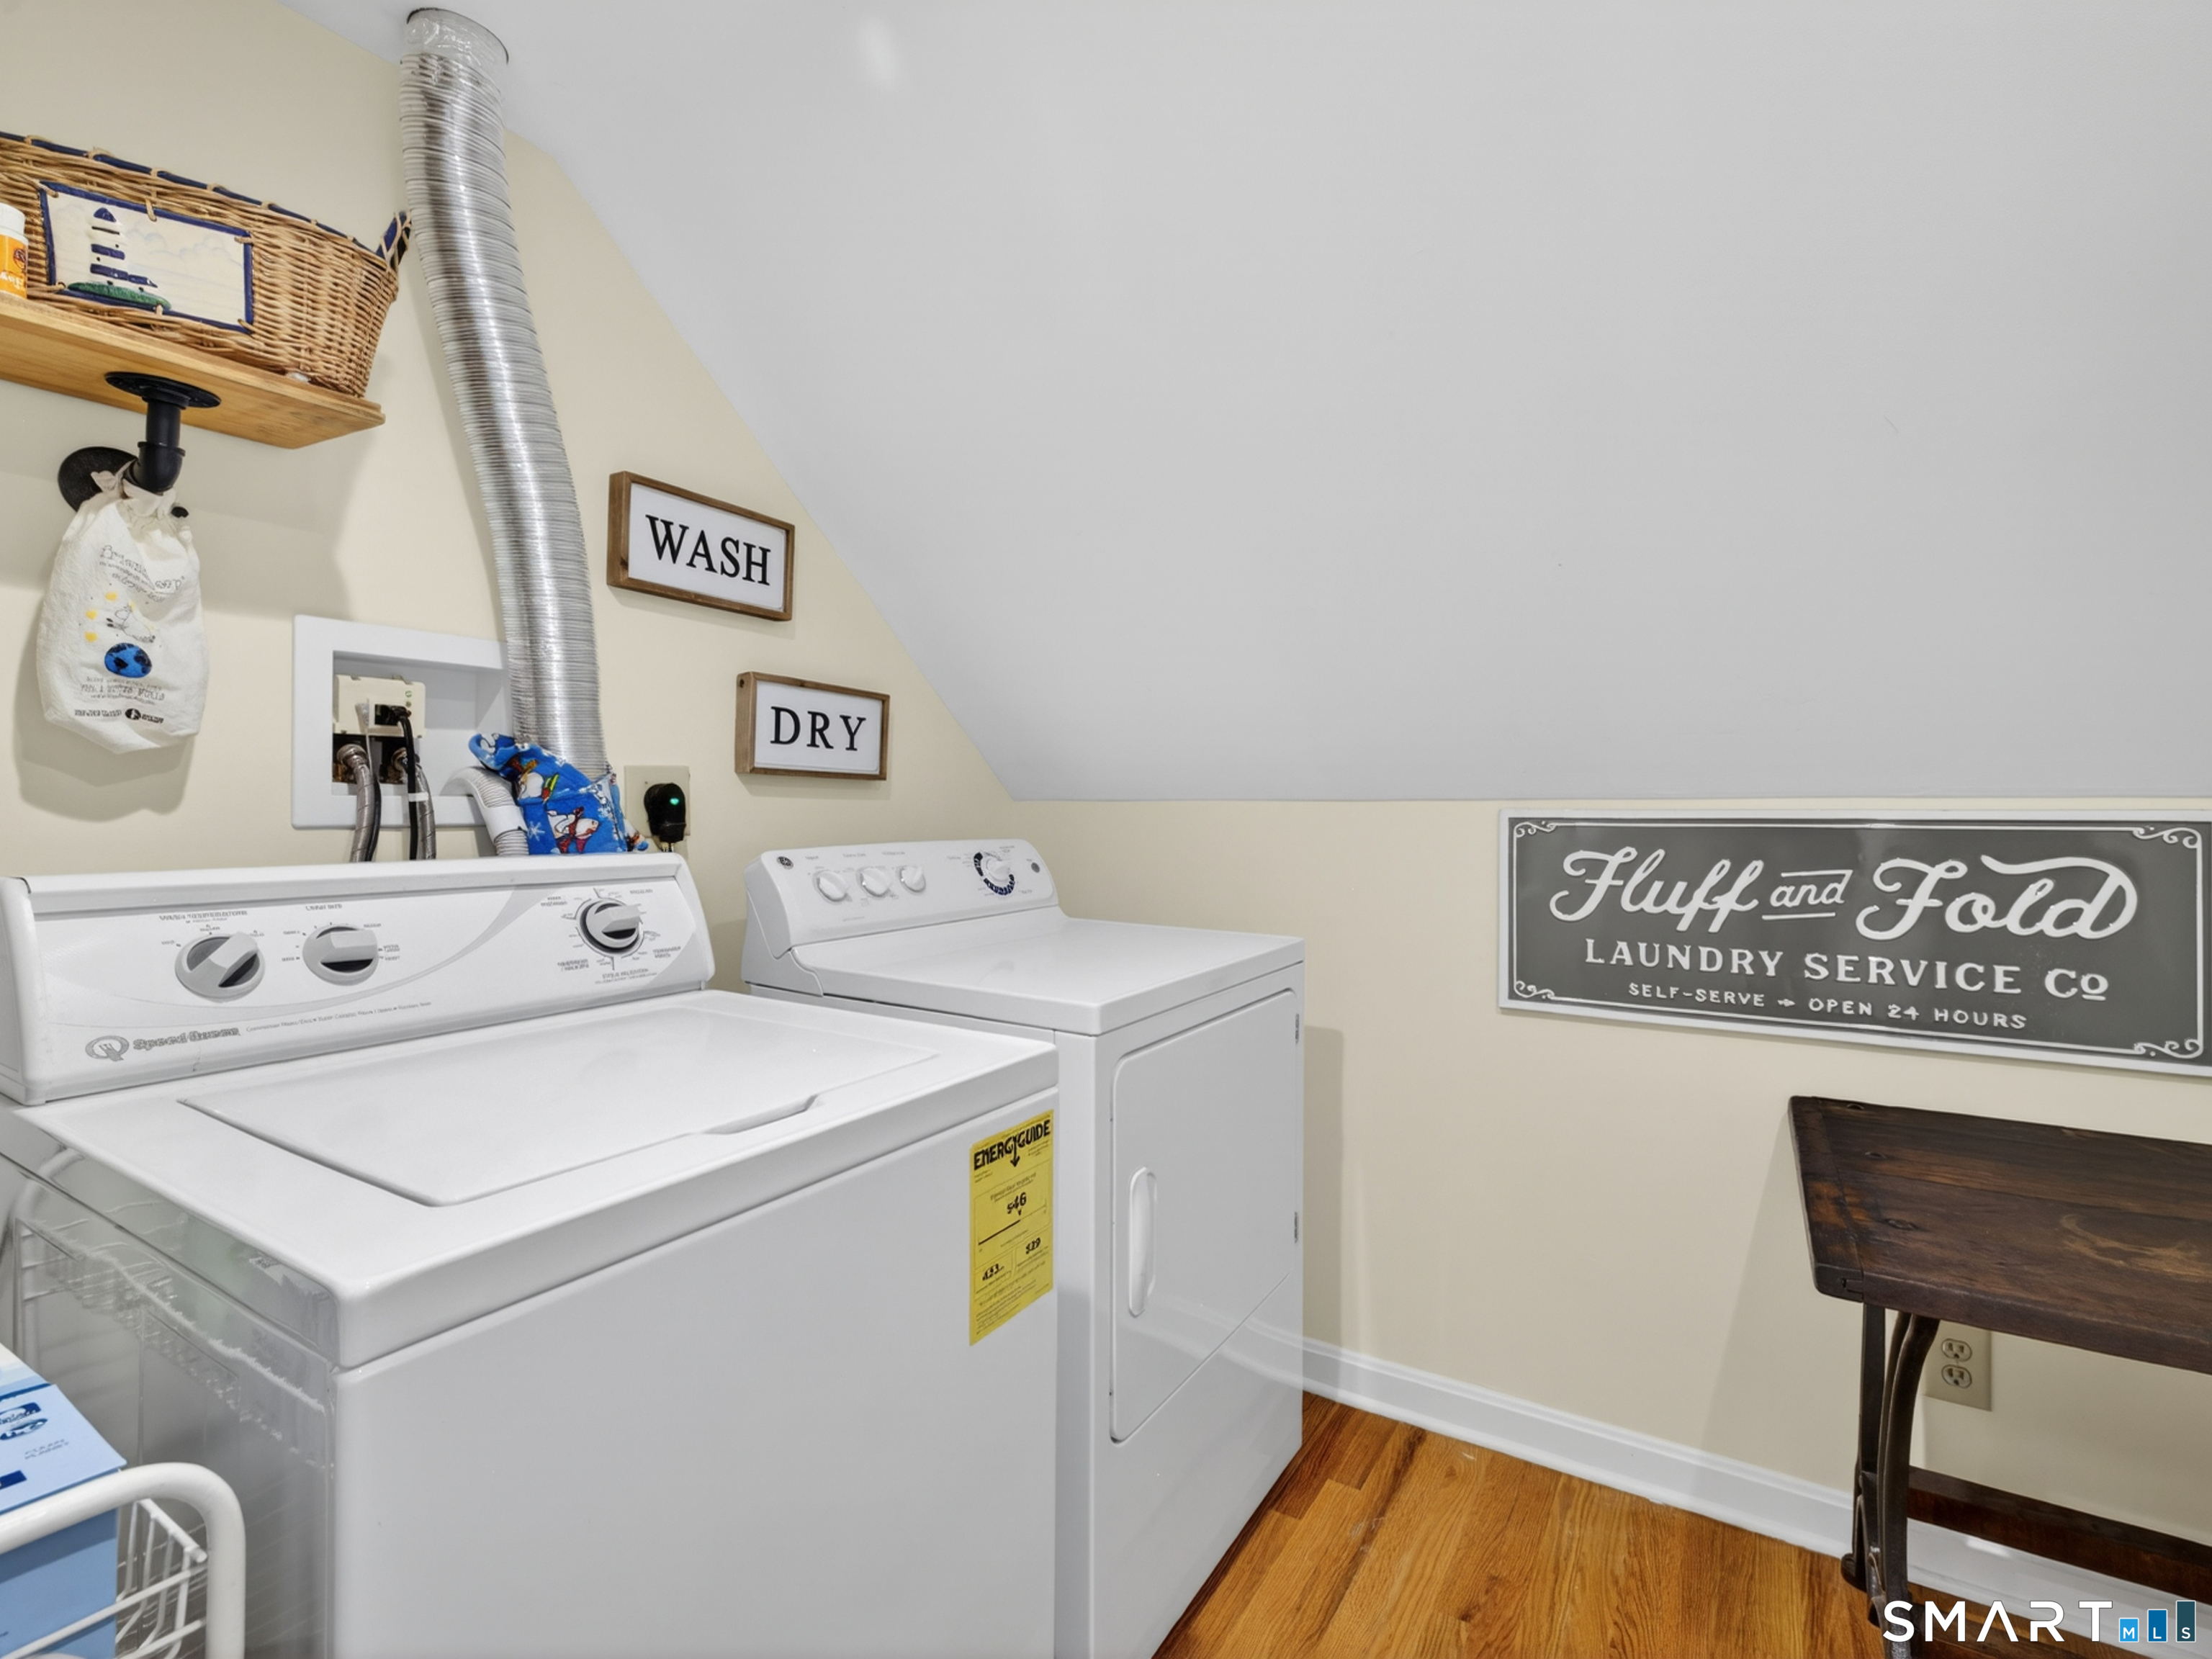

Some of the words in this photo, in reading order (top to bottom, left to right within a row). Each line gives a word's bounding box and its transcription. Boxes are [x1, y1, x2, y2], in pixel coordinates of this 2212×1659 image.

[645, 514, 771, 585] WASH
[770, 706, 866, 751] DRY
[1550, 846, 1764, 932] Fluff
[1770, 869, 1853, 907] and
[1856, 855, 2138, 940] Fold
[1586, 938, 1783, 976] LAUNDRY
[1804, 953, 2021, 994] SERVICE
[1629, 983, 1764, 1007] SELF-SERVE
[1808, 998, 1872, 1016] OPEN
[1887, 1004, 1920, 1021] 24
[1934, 1008, 2027, 1029] HOURS
